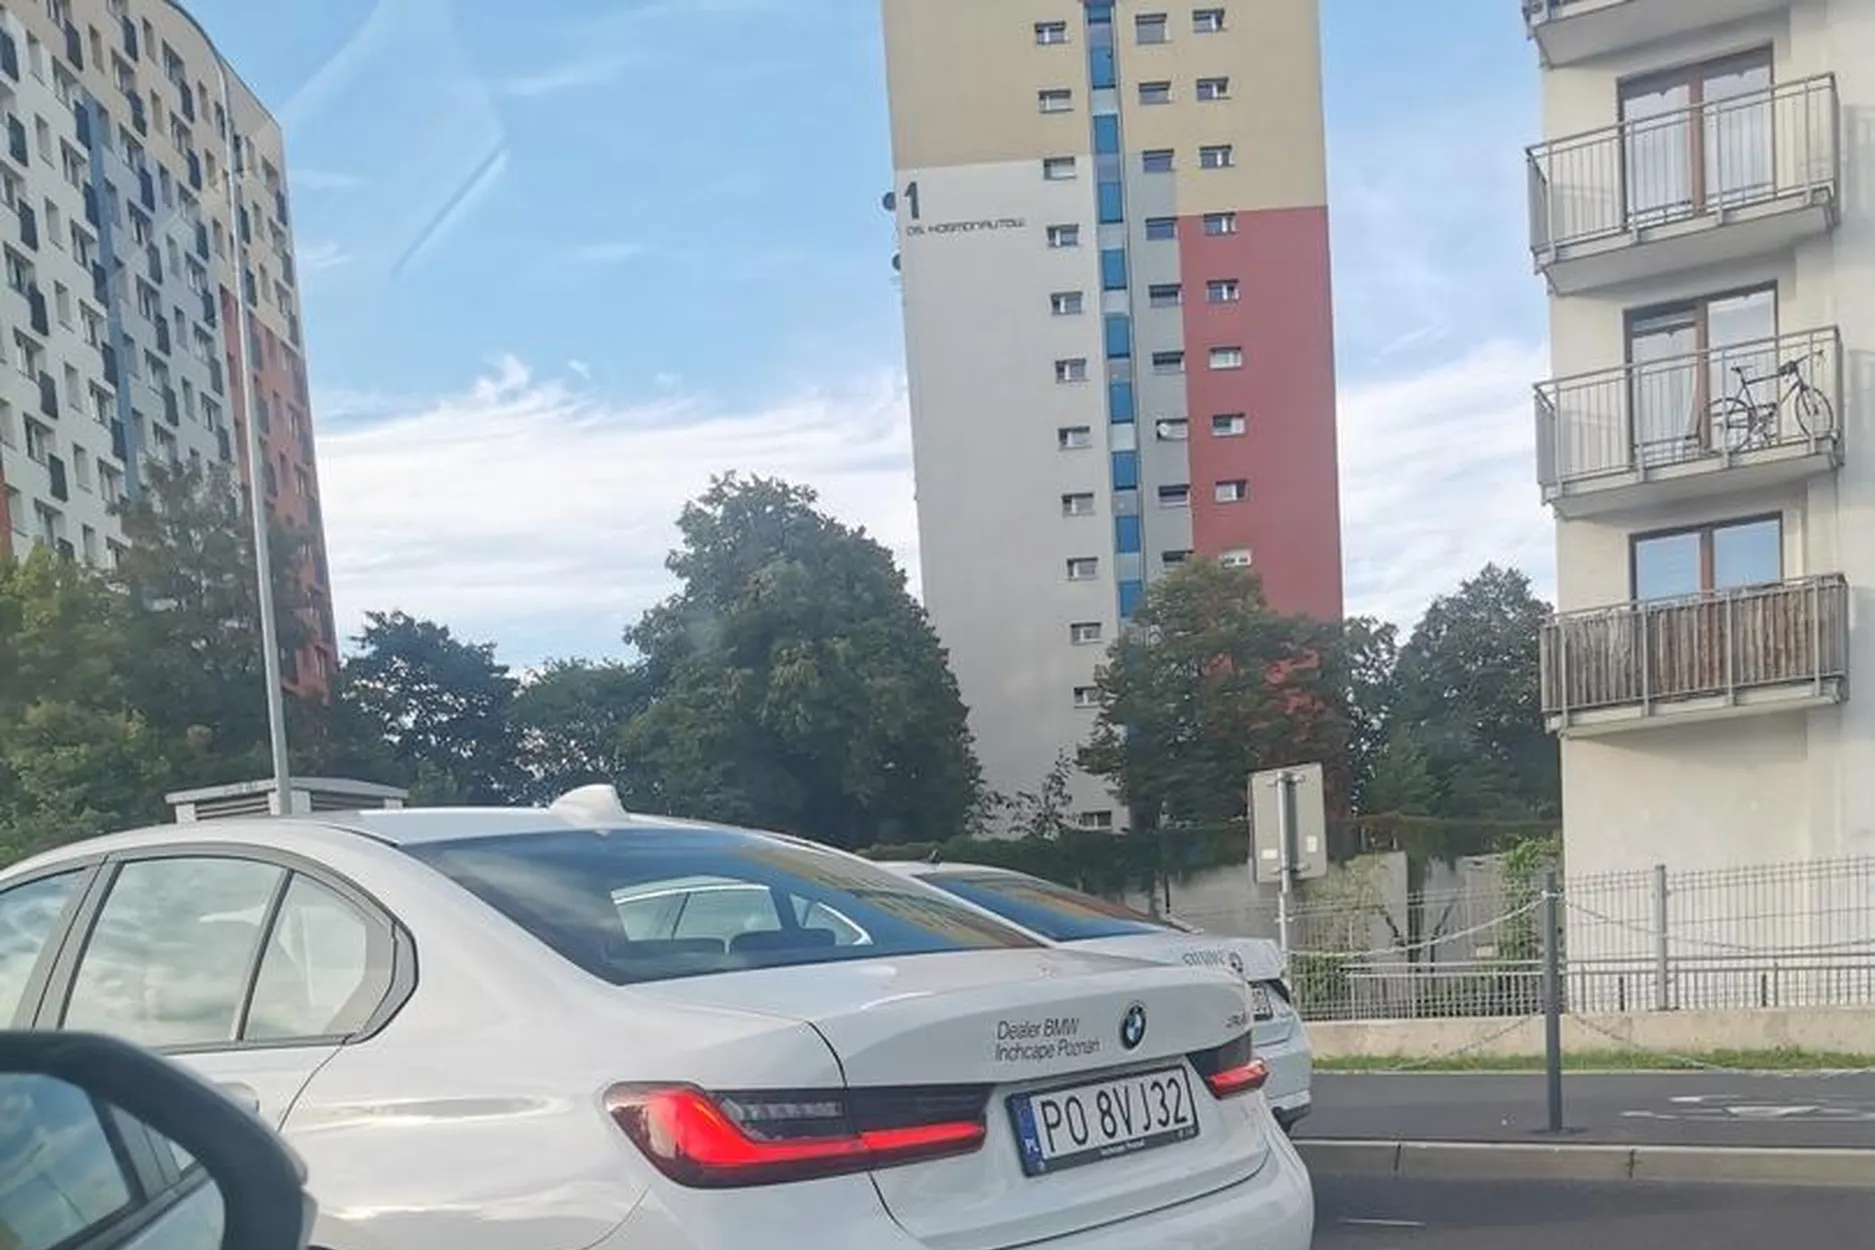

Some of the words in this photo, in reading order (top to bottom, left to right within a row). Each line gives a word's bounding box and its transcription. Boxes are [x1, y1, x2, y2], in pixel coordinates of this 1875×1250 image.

[904, 181, 920, 220] 1
[998, 1020, 1041, 1040] Dealer
[1043, 1017, 1080, 1037] BMW
[996, 1042, 1056, 1063] Inchcape
[1040, 1095, 1089, 1153] PO
[1096, 1077, 1188, 1139] 8VJ32
